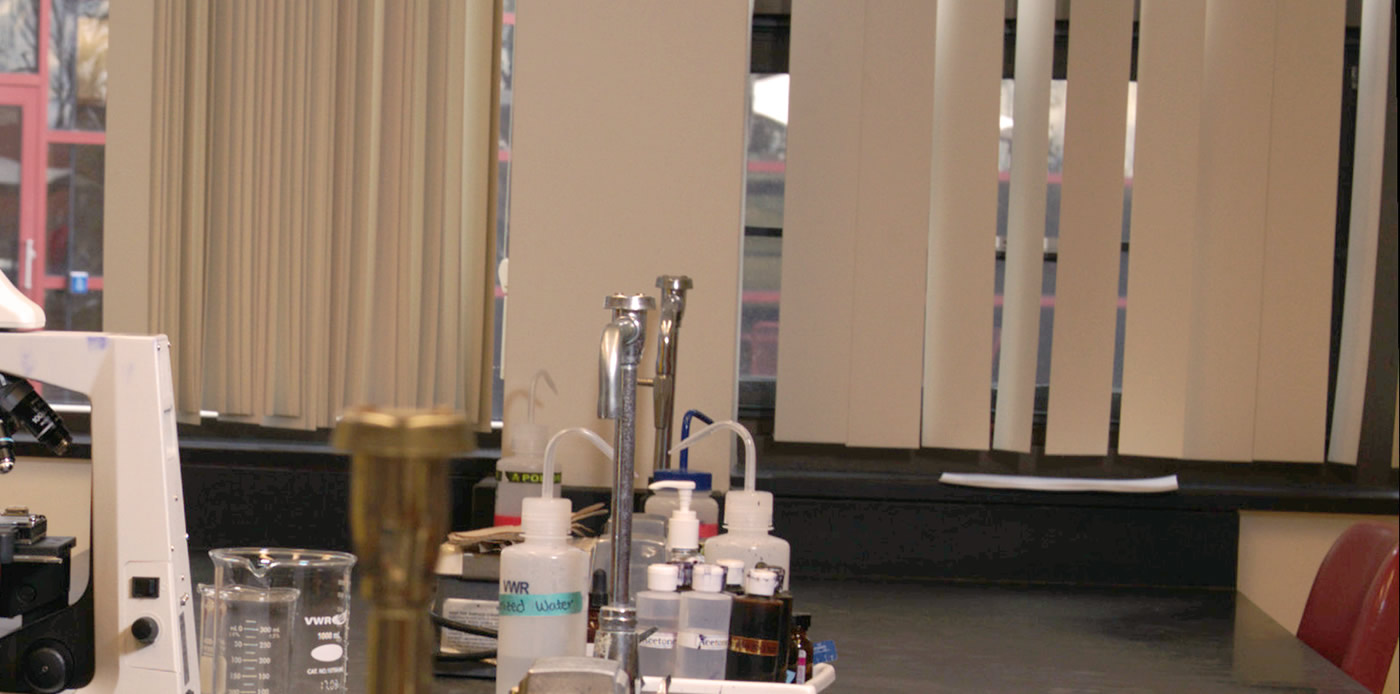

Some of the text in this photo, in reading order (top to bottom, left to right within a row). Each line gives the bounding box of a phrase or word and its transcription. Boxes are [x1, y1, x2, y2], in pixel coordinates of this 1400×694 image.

[503, 580, 529, 594] VWR
[535, 599, 574, 612] Water
[304, 616, 332, 625] VWR
